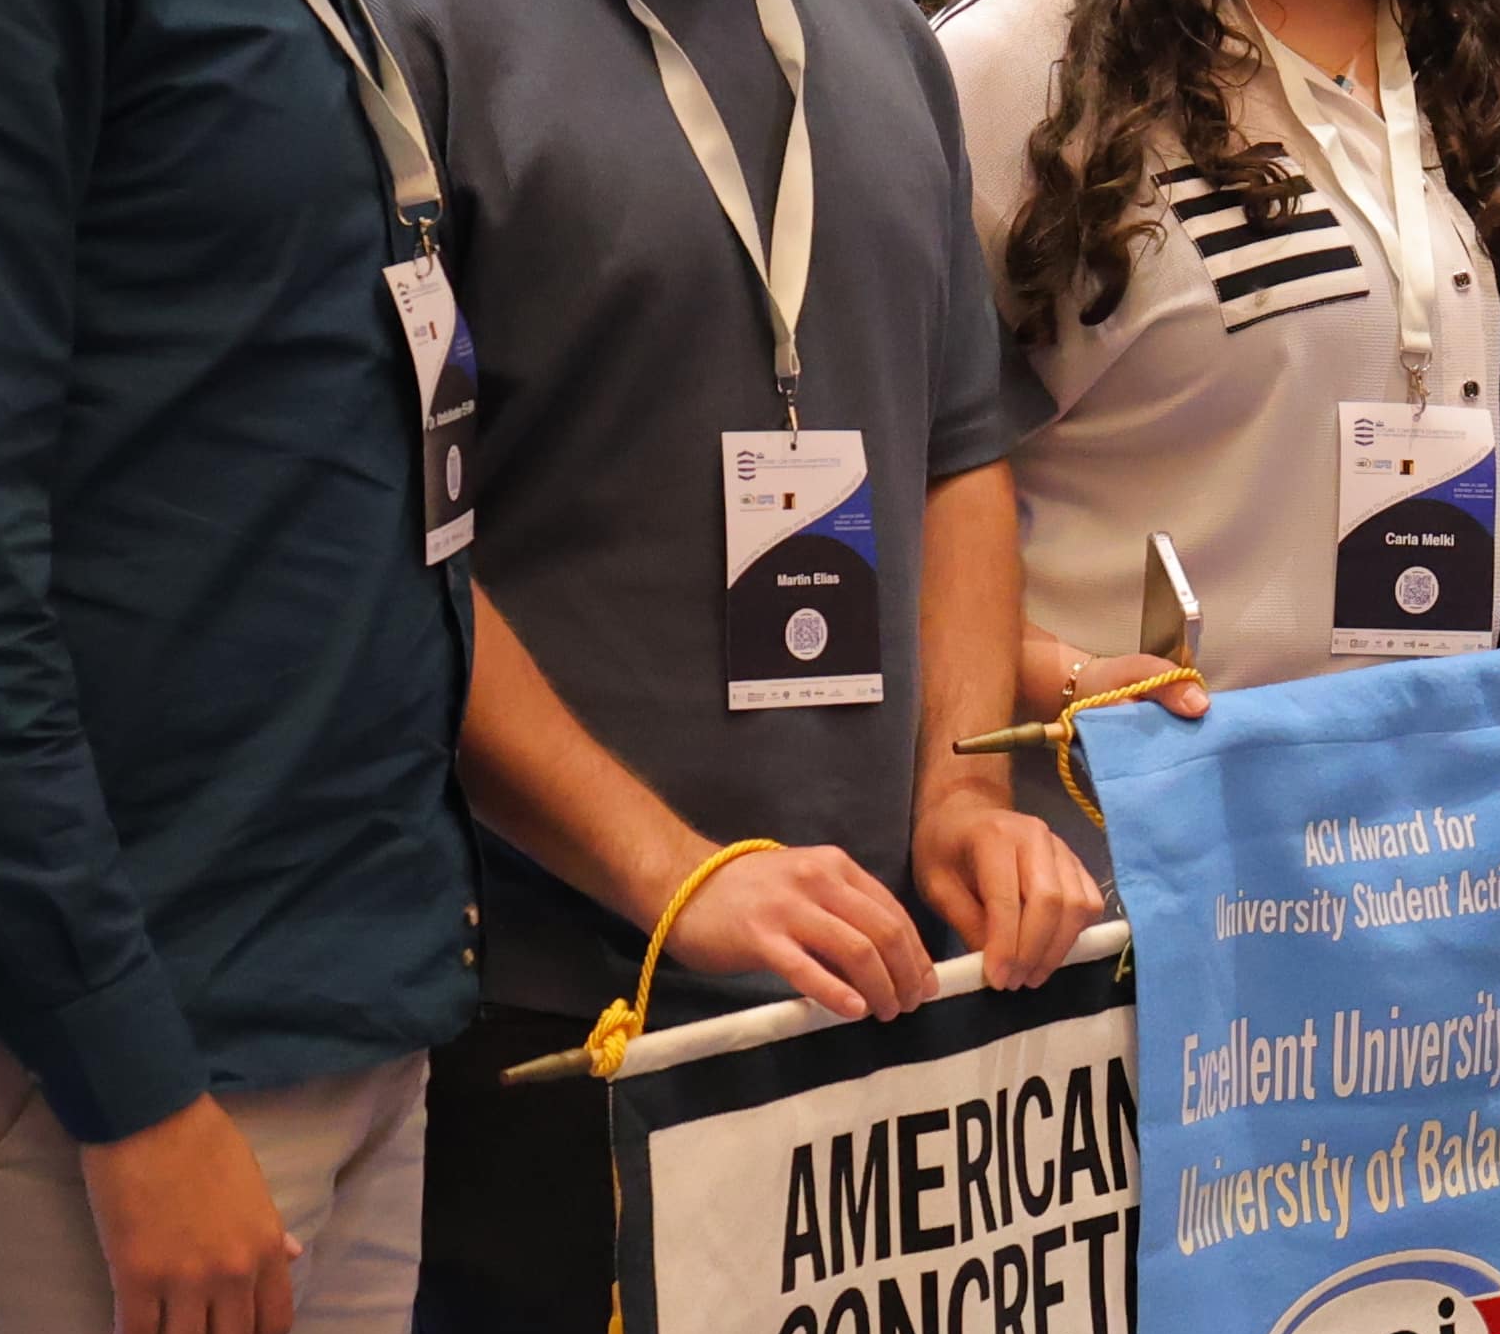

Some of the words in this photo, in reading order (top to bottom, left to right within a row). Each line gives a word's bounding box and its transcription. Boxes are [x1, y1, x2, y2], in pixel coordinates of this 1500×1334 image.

[1385, 532, 1419, 546] Carla
[1422, 533, 1456, 547] Melki
[777, 573, 812, 586] Martin
[813, 572, 840, 585] Elias
[1304, 817, 1344, 867] ACI
[1349, 809, 1430, 863] Award
[1434, 805, 1477, 851] for
[1215, 887, 1346, 942] University
[1353, 876, 1452, 930] Student
[1181, 1017, 1319, 1126] Excellent
[781, 1056, 1140, 1295] AMERICAN
[1176, 1138, 1355, 1257] University
[1365, 1124, 1408, 1214] of
